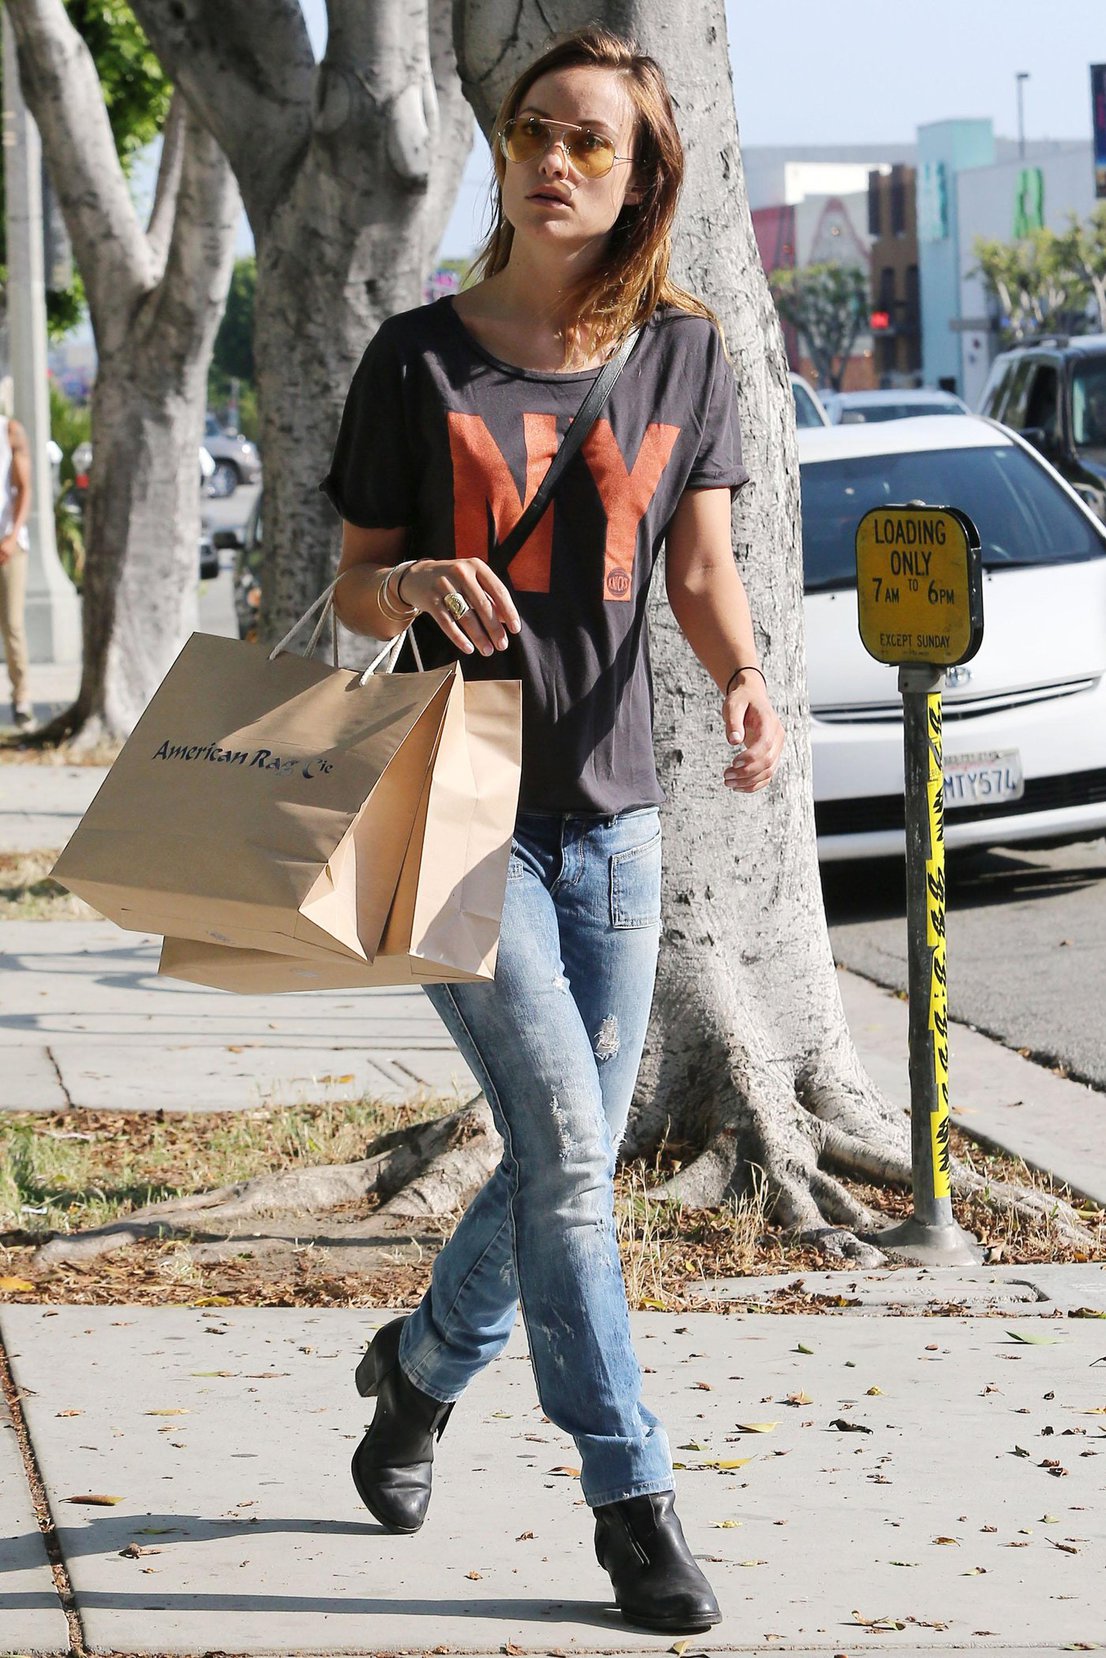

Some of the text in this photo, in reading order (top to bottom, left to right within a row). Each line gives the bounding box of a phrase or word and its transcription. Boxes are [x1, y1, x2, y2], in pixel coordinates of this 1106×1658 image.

[447, 411, 681, 602] NY
[874, 519, 946, 545] LOADING
[890, 550, 932, 577] ONLY
[908, 578, 919, 592] TO
[880, 633, 950, 648] EXCEPT SUNDAY
[151, 739, 249, 765] American
[249, 749, 300, 777] Rag
